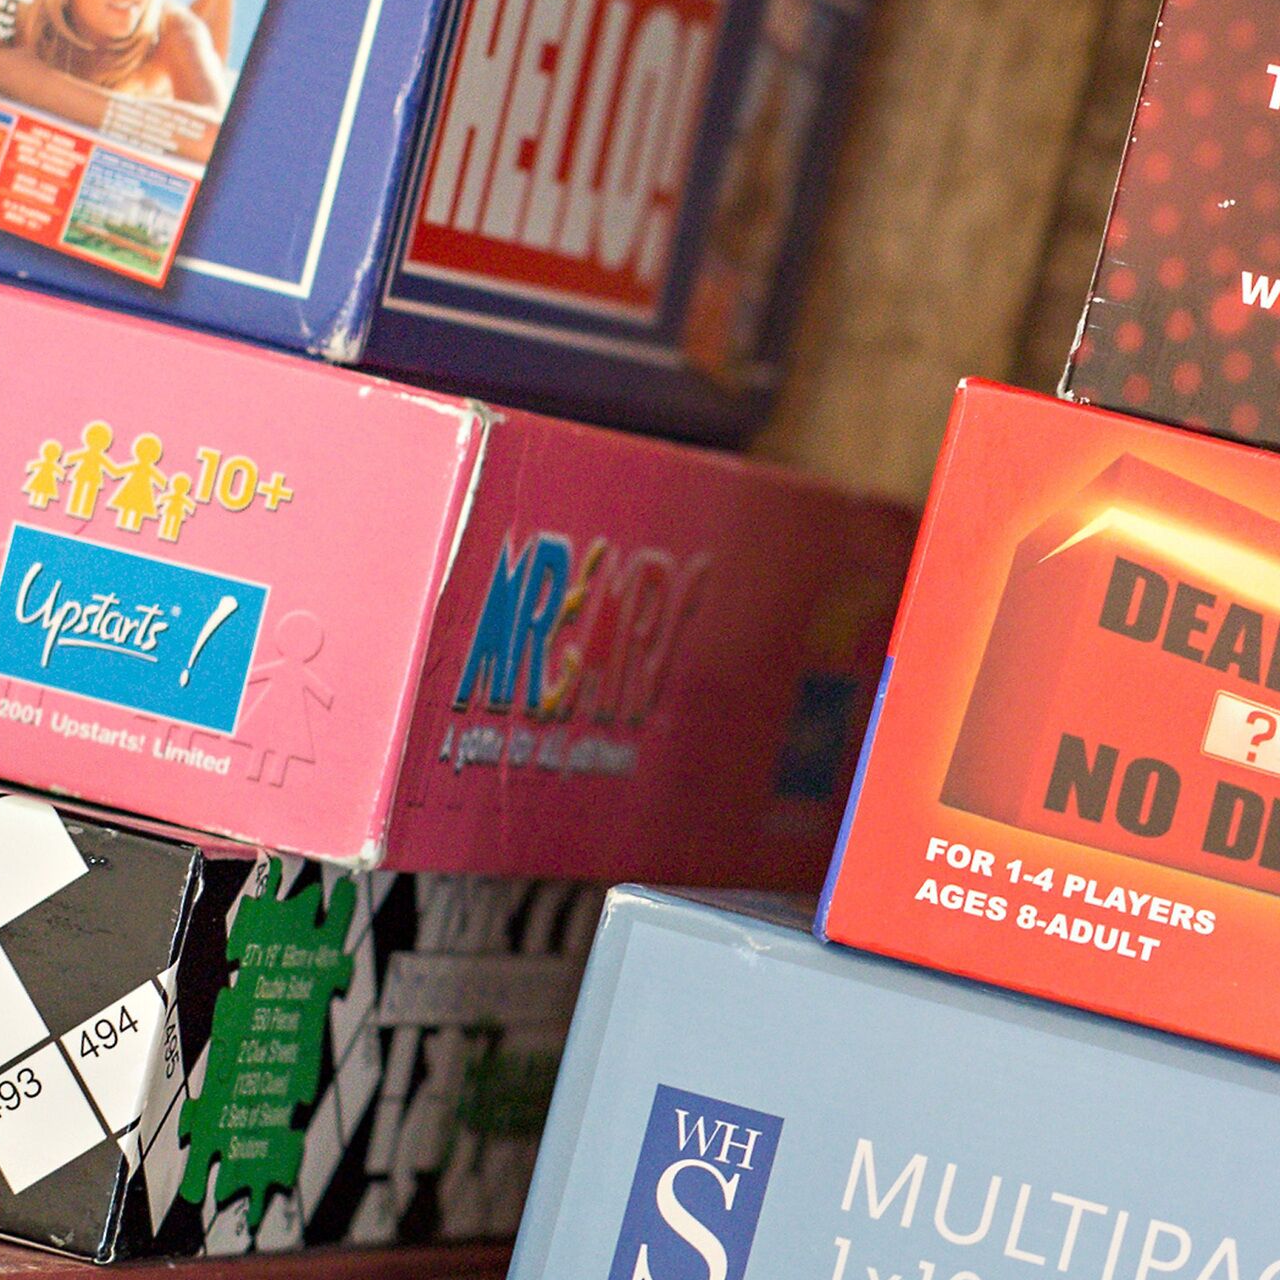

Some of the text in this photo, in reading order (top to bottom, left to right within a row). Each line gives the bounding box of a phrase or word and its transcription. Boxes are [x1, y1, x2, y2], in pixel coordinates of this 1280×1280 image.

[195, 446, 294, 513] 10+
[50, 713, 147, 754] Upstarts!
[152, 738, 232, 776] Limited
[1042, 731, 1182, 840] NO
[925, 836, 1217, 937] FOR 1-4 PLAYERS
[914, 878, 1161, 963] AGES 8-ADULT
[77, 1004, 140, 1064] 494
[671, 1106, 764, 1172] WH
